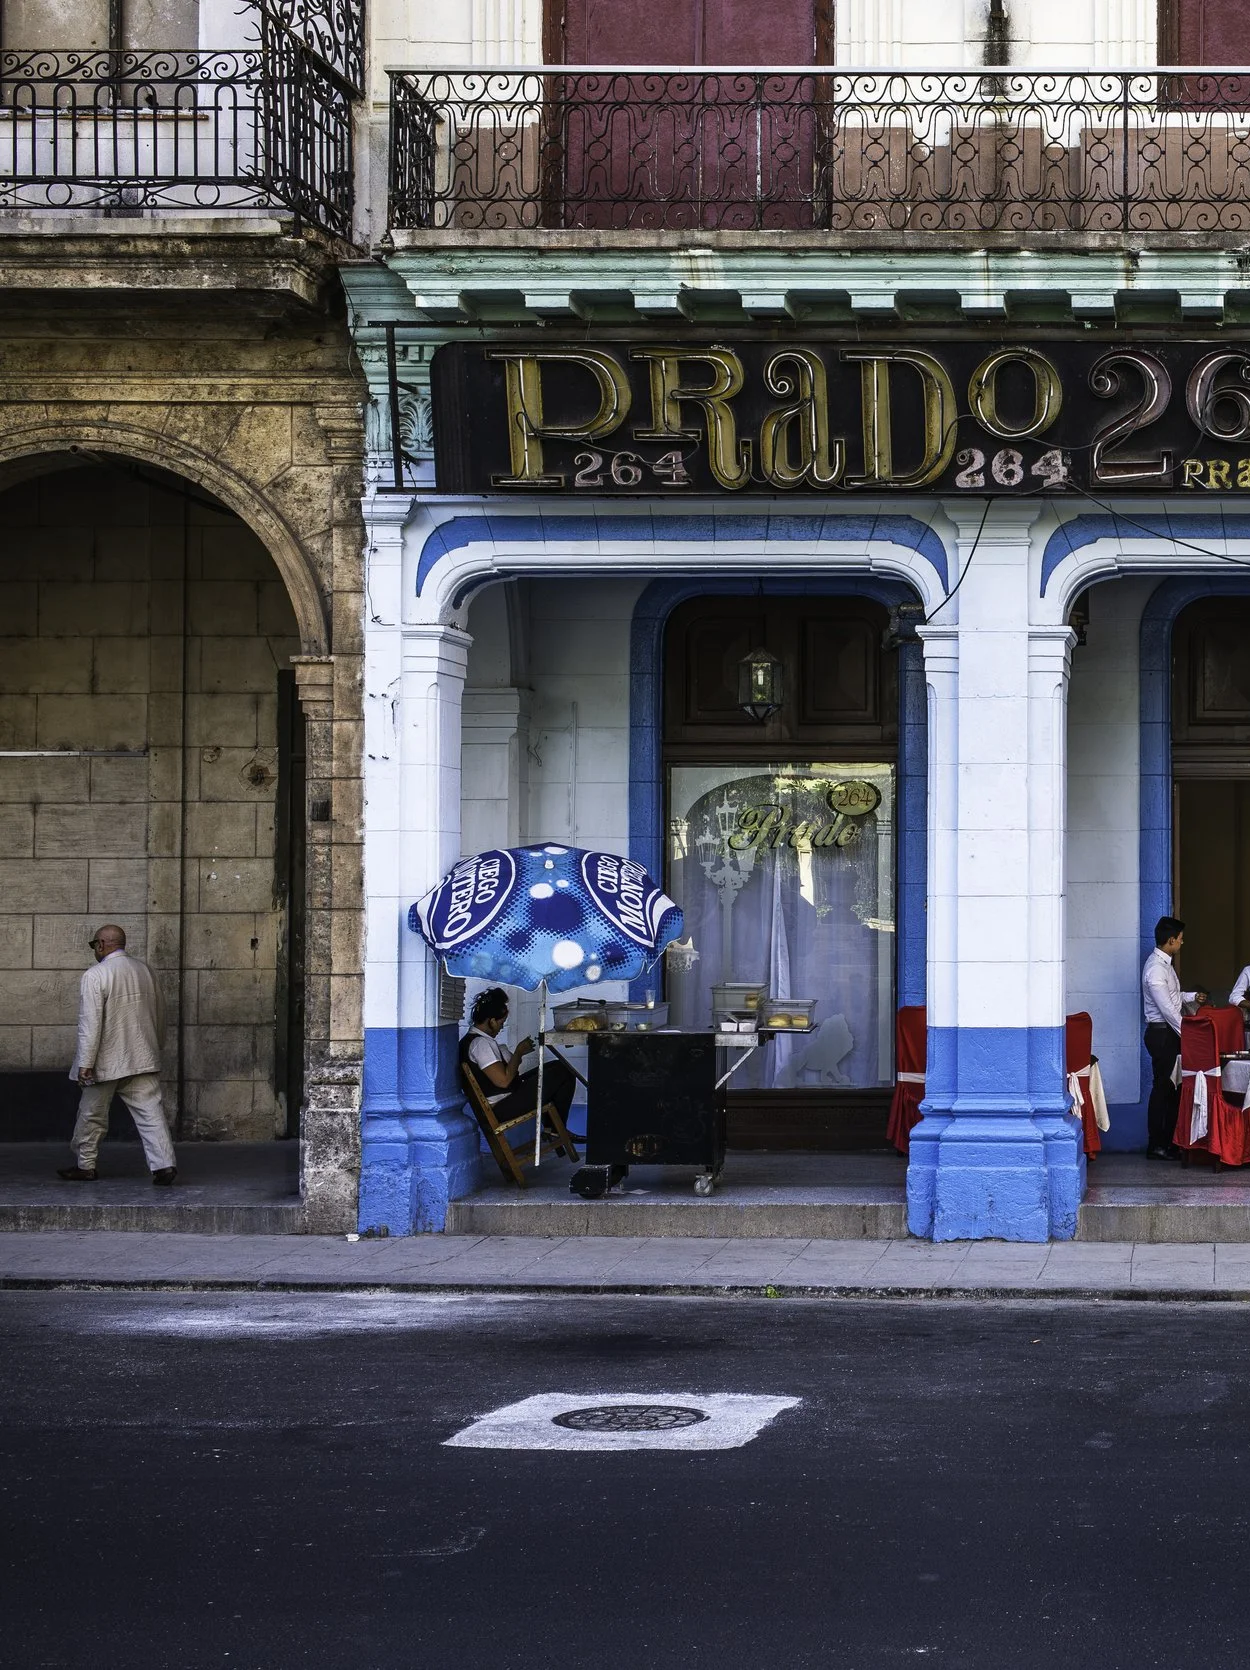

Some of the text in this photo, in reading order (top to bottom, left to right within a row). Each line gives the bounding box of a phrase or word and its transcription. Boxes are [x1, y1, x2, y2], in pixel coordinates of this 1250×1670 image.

[574, 449, 692, 487] 264
[955, 448, 1071, 488] 264
[838, 787, 873, 807] 264
[728, 803, 861, 850] Prado
[475, 858, 501, 904] CIEGO
[597, 855, 620, 894] CIEGO
